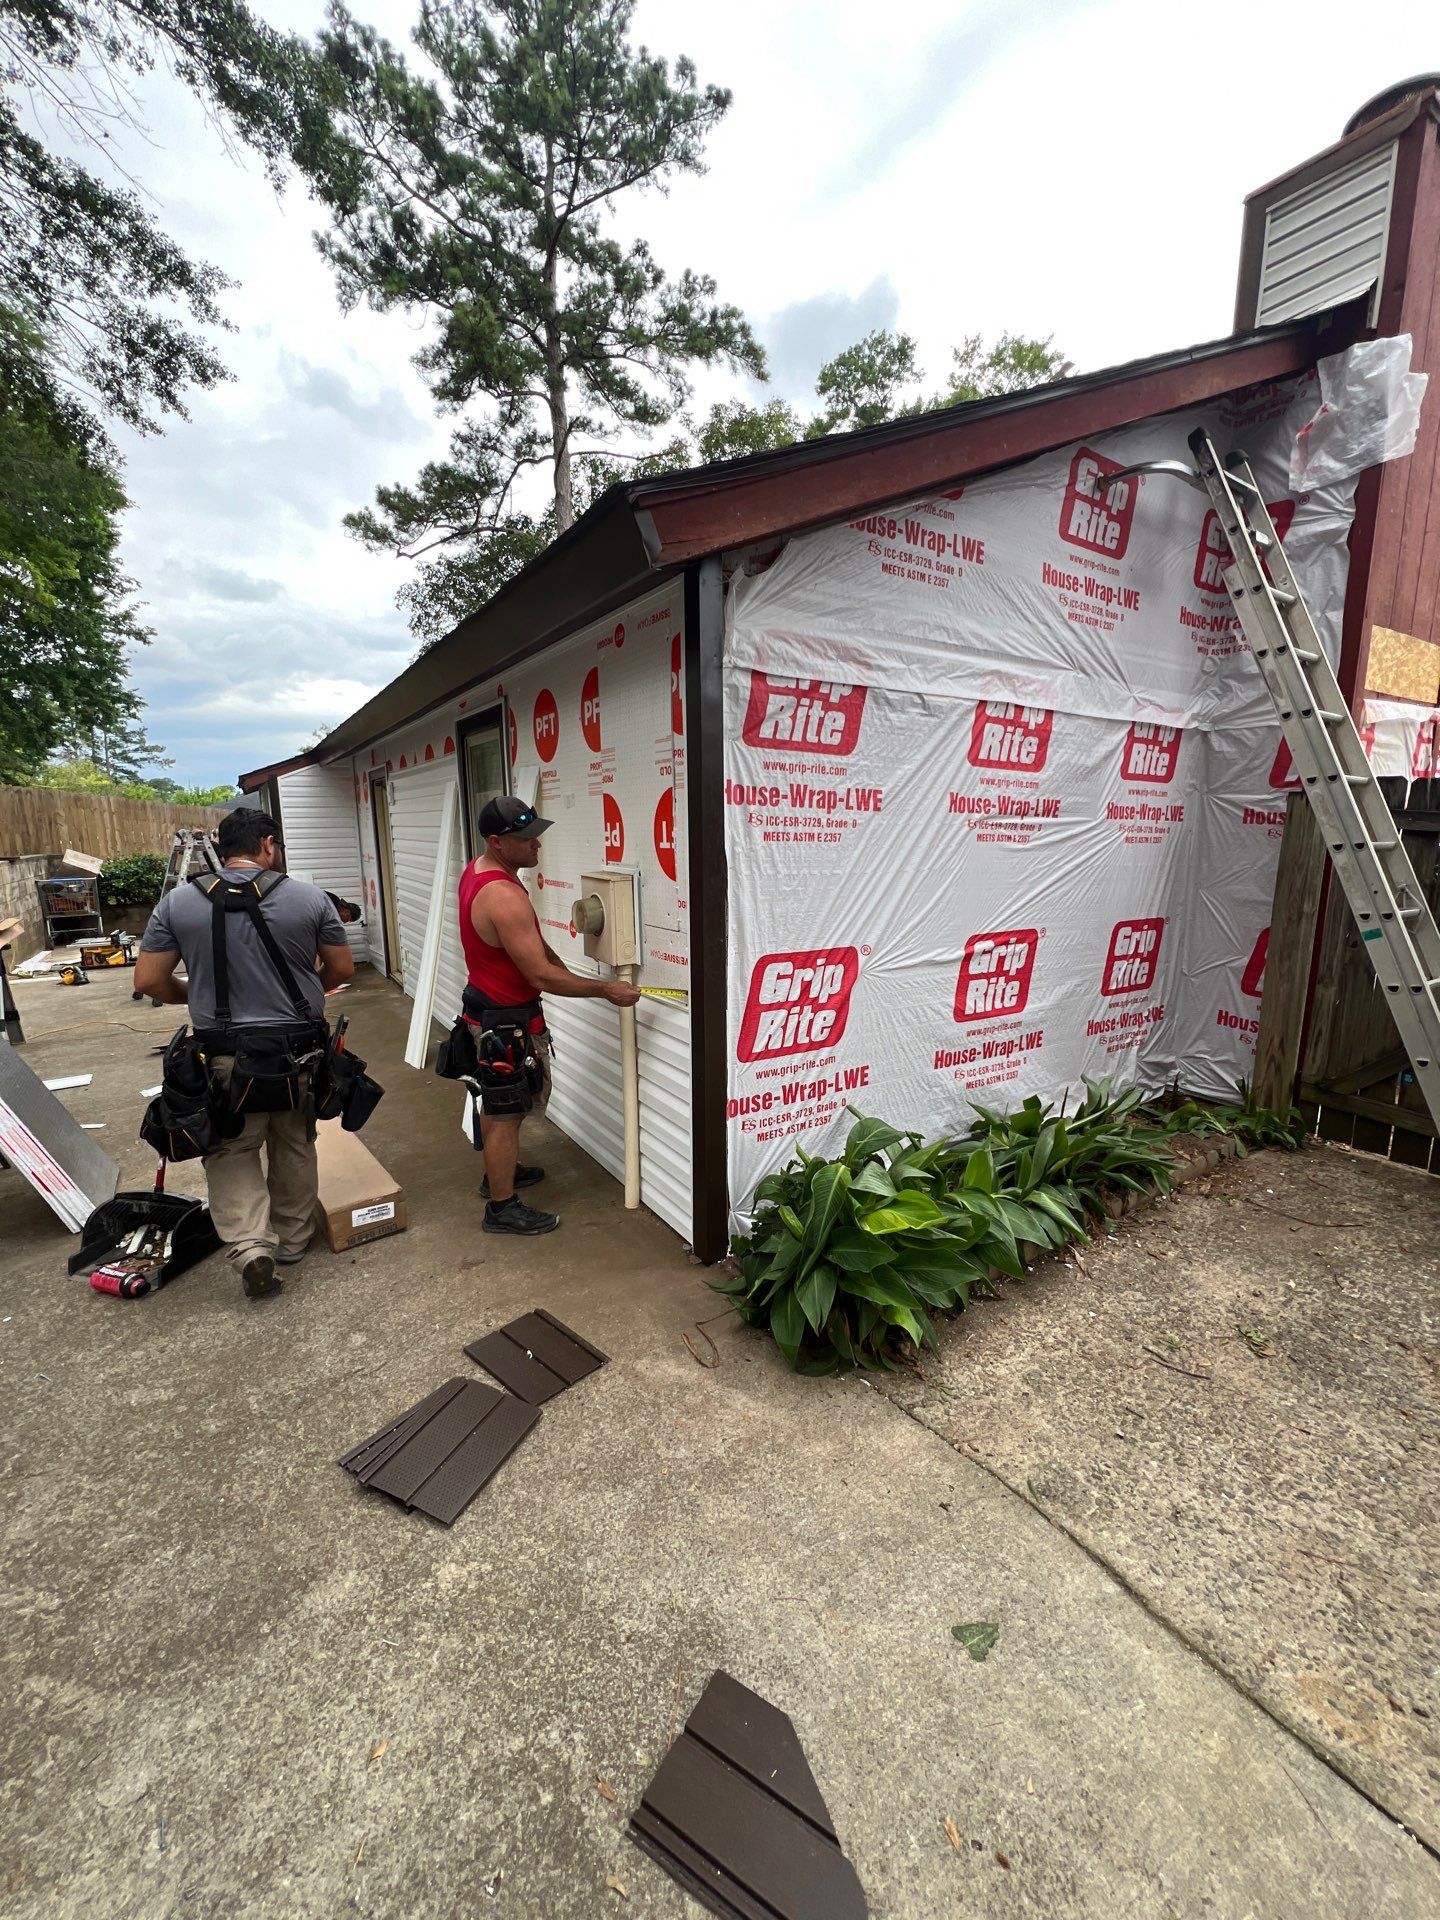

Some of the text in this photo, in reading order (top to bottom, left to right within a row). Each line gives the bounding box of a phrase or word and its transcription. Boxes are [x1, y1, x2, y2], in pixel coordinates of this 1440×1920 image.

[849, 515, 985, 564] ouse-Wrap-LWE
[1068, 499, 1121, 550] Rite
[881, 562, 950, 588] MEETS ASTM E 2357
[1042, 562, 1140, 611] House-Wrap-LWE
[535, 712, 555, 740] PFT
[758, 693, 846, 746] Rite
[978, 722, 1039, 765] Rite
[763, 760, 848, 777] www.grip-rite.com
[1128, 743, 1170, 777] Rite
[980, 777, 1039, 789] www.grip-rite.com
[949, 792, 1061, 820] House-Wrap-LWE
[1106, 801, 1184, 824] House-Wrap-LWE
[763, 831, 842, 843] MEETS ASTM E 2357
[766, 817, 824, 829] ICC-ESR-3729,
[826, 817, 848, 829] Grade
[977, 833, 996, 842] MEETS
[1114, 925, 1157, 957] Grip
[968, 937, 1029, 976] Grip
[759, 958, 845, 1004] Grip
[1108, 957, 1149, 990] Rite
[965, 976, 1020, 1015] Rite
[752, 1005, 836, 1054] Rite
[966, 1021, 1023, 1037] www.grip-rite.com
[934, 1030, 1044, 1070] House-Wrap-LWE
[756, 1055, 836, 1080] www.grip-rite.com
[965, 1078, 985, 1090] MEETS
[986, 1075, 1000, 1086] ASTM
[726, 1065, 870, 1120] ouse-Wrap-LWE
[757, 1115, 832, 1142] MEETS ASTM E 2357
[759, 1105, 815, 1129] ICC-ESR-3729,
[817, 1101, 838, 1114] Grade
